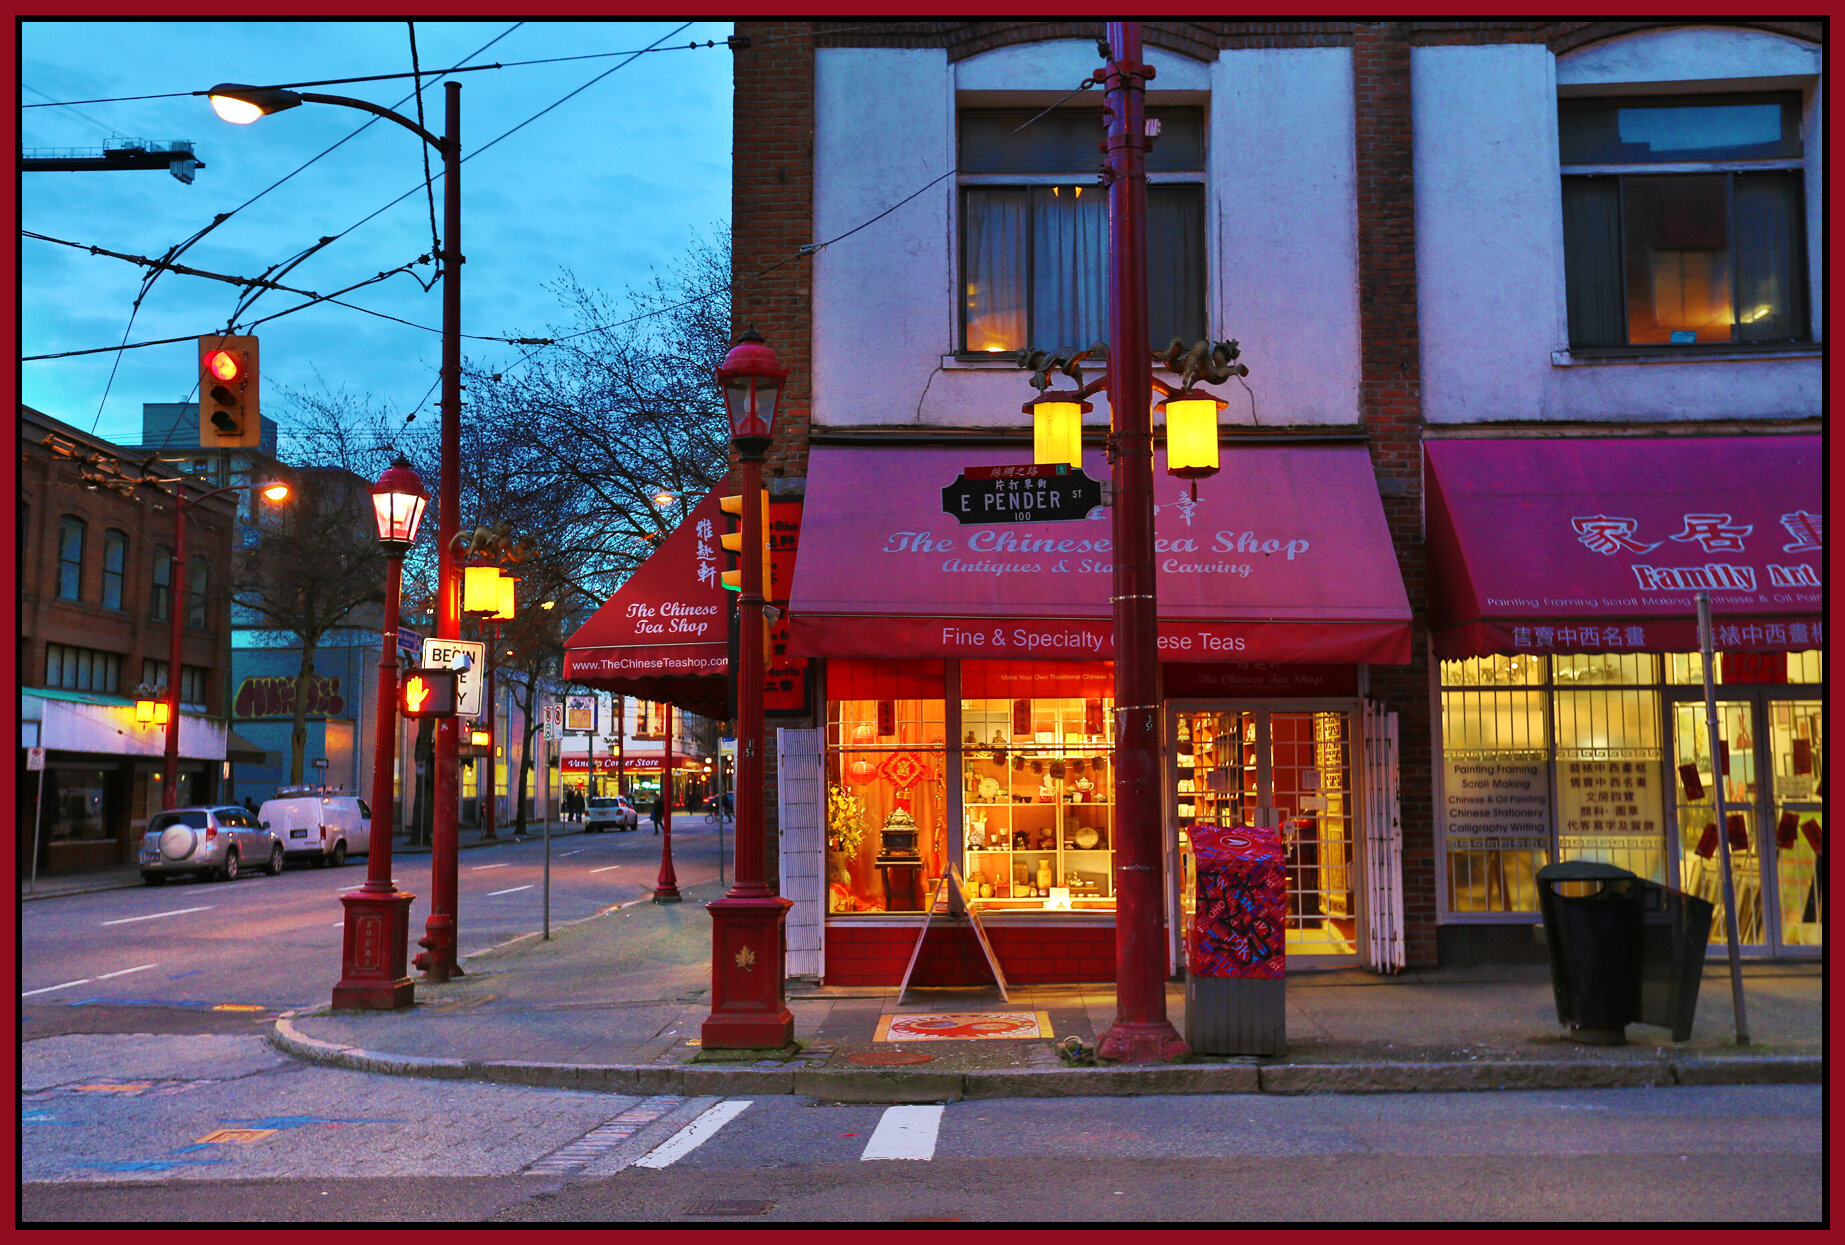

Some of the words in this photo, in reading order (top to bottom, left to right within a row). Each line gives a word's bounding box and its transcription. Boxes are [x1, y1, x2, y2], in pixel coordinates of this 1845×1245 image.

[961, 494, 971, 512] E
[984, 490, 1061, 511] PENDER
[1072, 490, 1083, 499] ST
[1014, 512, 1031, 521] 100
[882, 530, 955, 553] The
[968, 530, 1113, 553] Chinese
[1154, 531, 1198, 553] ea
[1211, 530, 1310, 561] Shop
[942, 558, 1042, 577] Antiques
[1051, 559, 1071, 573] &
[1162, 558, 1254, 578] Carving
[1631, 563, 1757, 592] Family
[1766, 563, 1821, 587] Art
[1487, 598, 1540, 608] Painting
[1544, 597, 1599, 608] Framing
[1602, 597, 1638, 607] Scroll
[1642, 596, 1691, 607] Making
[1709, 595, 1754, 605] hinese
[1759, 594, 1770, 603] &
[1773, 593, 1793, 603] Oil
[626, 603, 656, 618] The
[660, 601, 718, 616] Chinese
[634, 619, 664, 634] Tea
[668, 618, 708, 636] Shop
[942, 627, 984, 646] Fine
[992, 628, 1006, 646] &
[1013, 628, 1104, 651] Specialty
[1198, 632, 1247, 651] Teas
[1512, 625, 1646, 647] 售賣中西名畫
[1196, 673, 1218, 684] The
[1220, 672, 1265, 684] Chinese
[1268, 673, 1290, 684] Tea
[1292, 673, 1323, 687] Shop
[635, 758, 659, 768] Store
[1454, 765, 1494, 775] Painting
[1497, 765, 1538, 775] Framing
[1462, 779, 1489, 789] Scroll
[1492, 779, 1530, 790] Making
[1448, 795, 1485, 804] Chinese
[1495, 795, 1508, 803] Oil
[1510, 795, 1545, 805] Painting
[1449, 808, 1490, 818] Chinese
[1493, 807, 1544, 819] Stationery
[1449, 822, 1508, 834] Calligraphy
[1510, 822, 1545, 833] Writing
